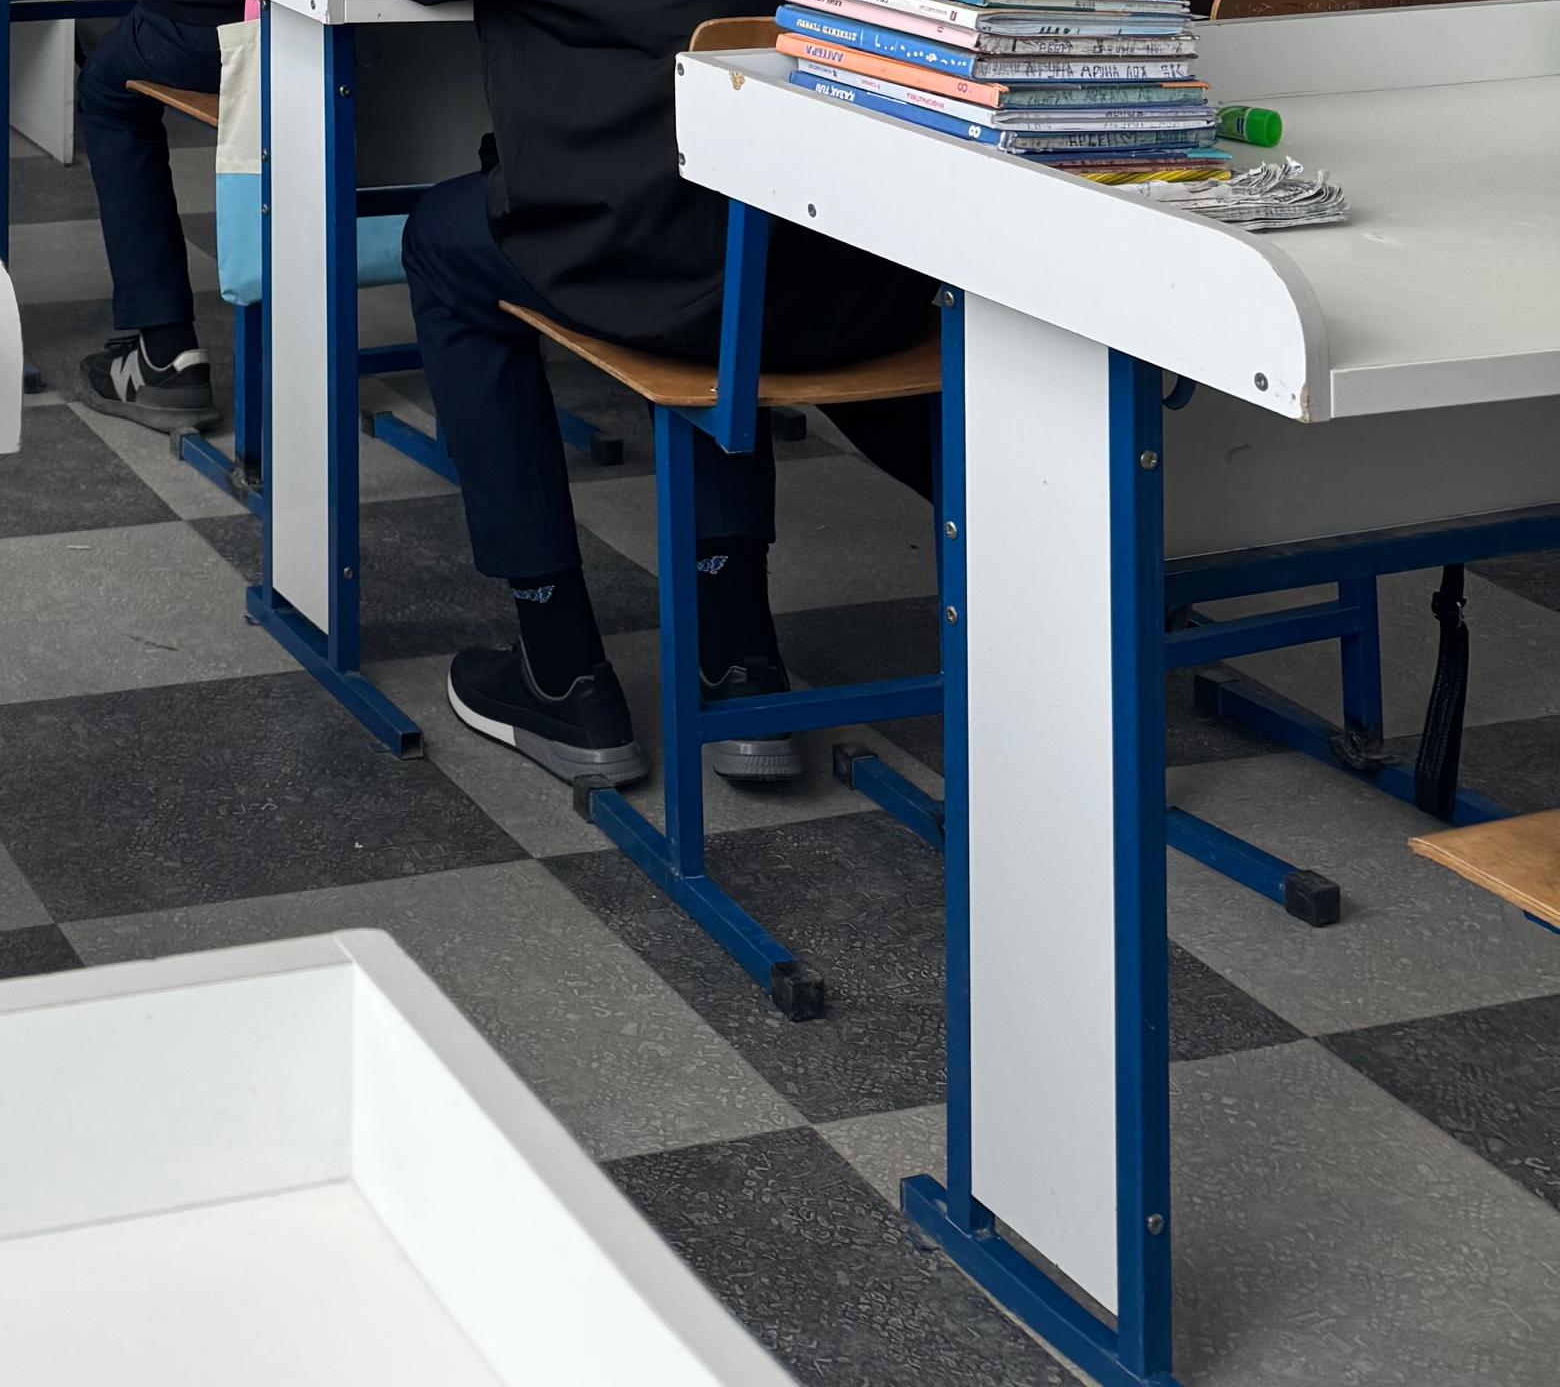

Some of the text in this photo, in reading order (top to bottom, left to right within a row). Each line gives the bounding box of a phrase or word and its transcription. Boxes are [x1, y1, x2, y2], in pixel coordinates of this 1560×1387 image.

[805, 45, 844, 63] АЛГЕБРА
[829, 86, 856, 102] ҚАЗАҚ
[968, 125, 981, 139] 8
